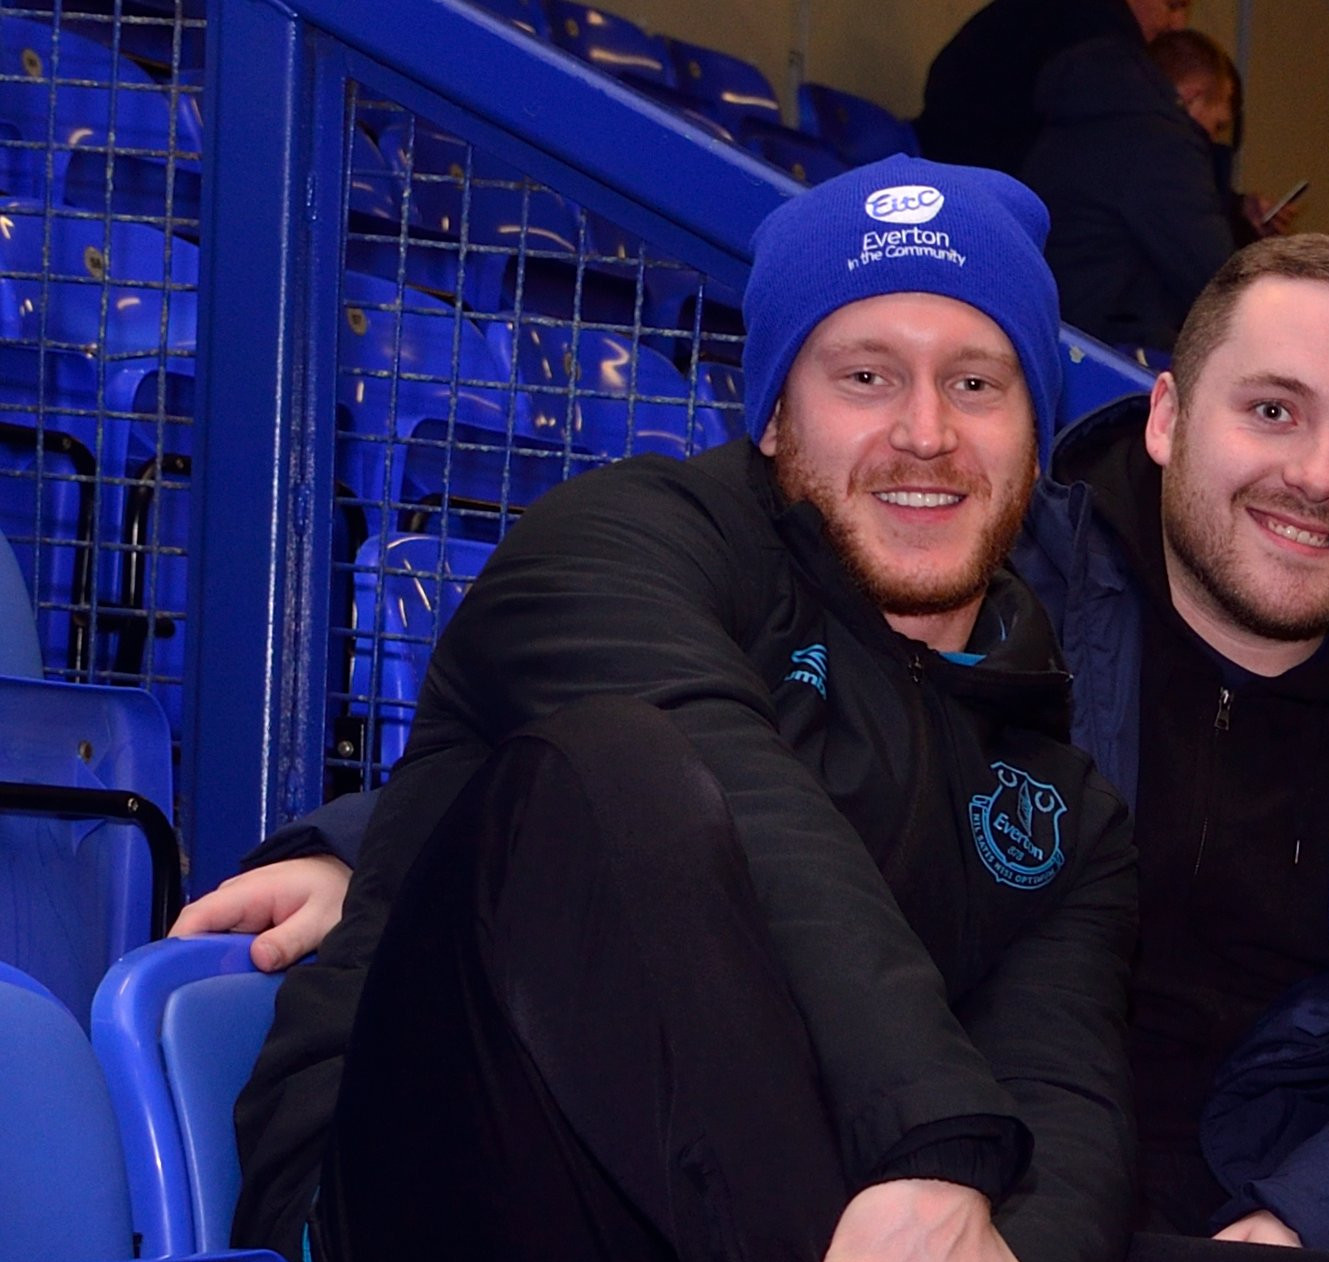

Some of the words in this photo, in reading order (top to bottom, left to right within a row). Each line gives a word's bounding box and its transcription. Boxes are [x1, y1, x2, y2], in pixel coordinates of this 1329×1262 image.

[862, 226, 950, 251] Everton
[860, 249, 883, 265] the
[885, 245, 967, 268] Community
[993, 812, 1044, 861] Everton
